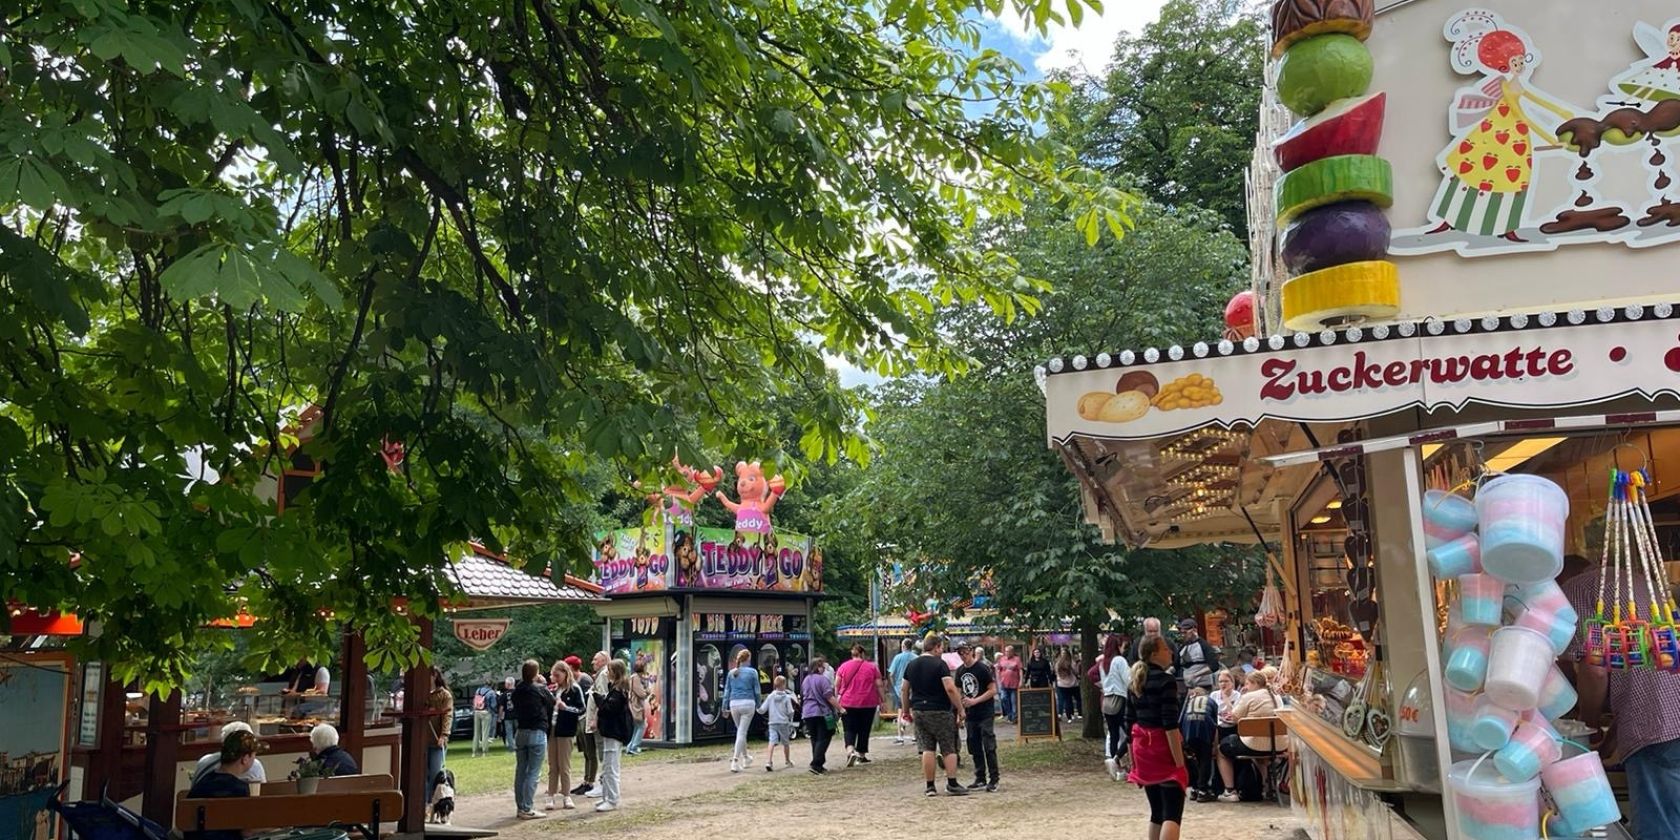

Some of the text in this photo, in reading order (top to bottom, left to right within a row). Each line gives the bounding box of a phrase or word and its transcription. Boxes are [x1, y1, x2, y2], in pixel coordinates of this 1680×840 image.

[1260, 347, 1573, 400] Zuckerwatte
[648, 553, 670, 575] GO
[701, 541, 804, 588] TEDDY 2 GO
[463, 628, 502, 641] Leber
